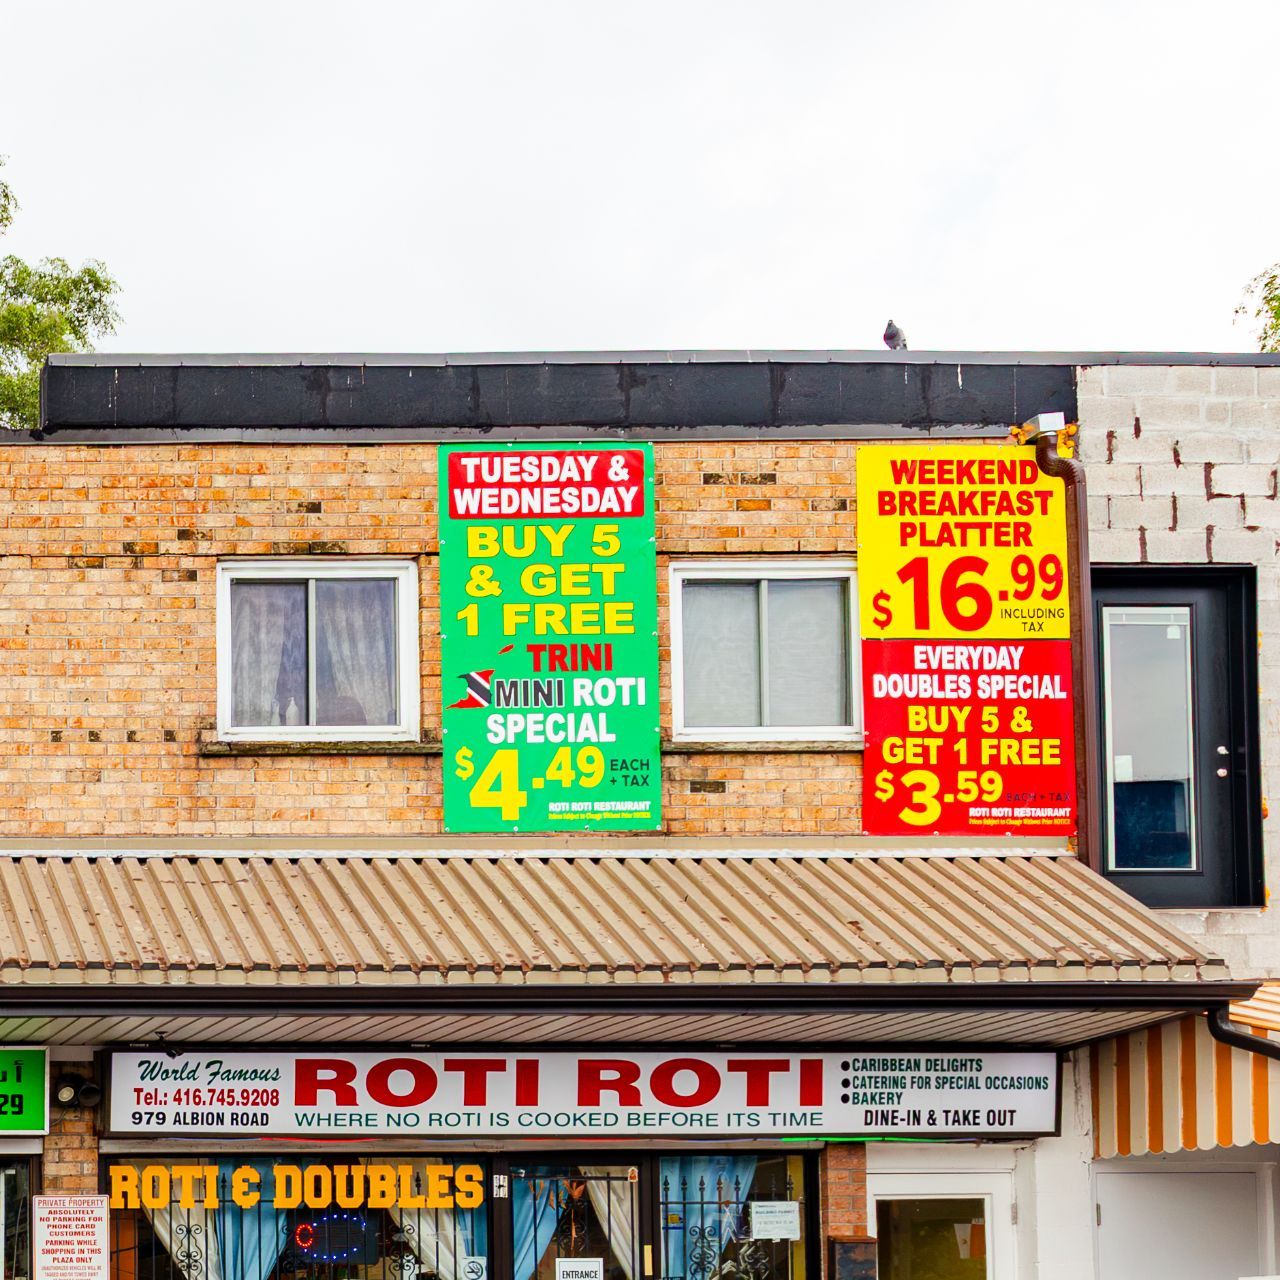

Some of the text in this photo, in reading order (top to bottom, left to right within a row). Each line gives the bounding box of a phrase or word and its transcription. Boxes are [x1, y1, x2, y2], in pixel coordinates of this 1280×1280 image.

[460, 455, 630, 483] TUESDAY &
[890, 459, 1038, 485] WEEKEND
[453, 486, 638, 515] WEDNESDAY
[878, 490, 1053, 516] BREAKFAST
[466, 524, 621, 558] BUY 5
[900, 522, 1033, 547] PLATTER
[464, 563, 625, 597] & GET
[872, 553, 1064, 632] $16.99
[456, 603, 635, 636] 1 FREE
[1000, 608, 1065, 619] INCLUDING
[1021, 621, 1045, 632] TAX
[527, 643, 613, 672] TRINI
[913, 645, 1024, 670] EVERYDAY
[495, 677, 646, 709] MINI ROTI
[873, 675, 1067, 699] DOUBLES SPECIAL
[486, 713, 616, 744] SPECIAL
[908, 706, 1034, 733] BUY 5 &
[882, 738, 1061, 765] GET 1 FREE
[610, 759, 650, 771] EACH
[455, 746, 605, 821] $4.49
[610, 775, 650, 787] + TAX
[548, 802, 651, 812] ROTI ROTI RESTAURANT
[874, 769, 1003, 826] $3.59
[1006, 792, 1070, 801] EACH TAX
[969, 808, 1071, 817] ROTI ROTI RESTAURANT
[137, 1059, 282, 1084] World Famous
[852, 1058, 983, 1072] CARIBBEAN DELIGHTS
[294, 1058, 824, 1108] ROTI ROTI
[852, 1075, 1049, 1090] CATERING FOR SPECIAL OCCASIONS
[133, 1087, 281, 1108] Tel.: 416.745.9208
[852, 1091, 903, 1106] BAKERY
[131, 1111, 269, 1127] 979 ALBION ROAD
[294, 1112, 824, 1128] WHERE NO ROTI IS COOKED BEFORE ITS TIME
[864, 1109, 1016, 1127] DINE-IN & TAKE OUT
[109, 1164, 485, 1209] ROTI & DOUBLES
[37, 1199, 104, 1207] PRIVATE PROPERTY
[562, 1270, 599, 1279] ENTRANCE
